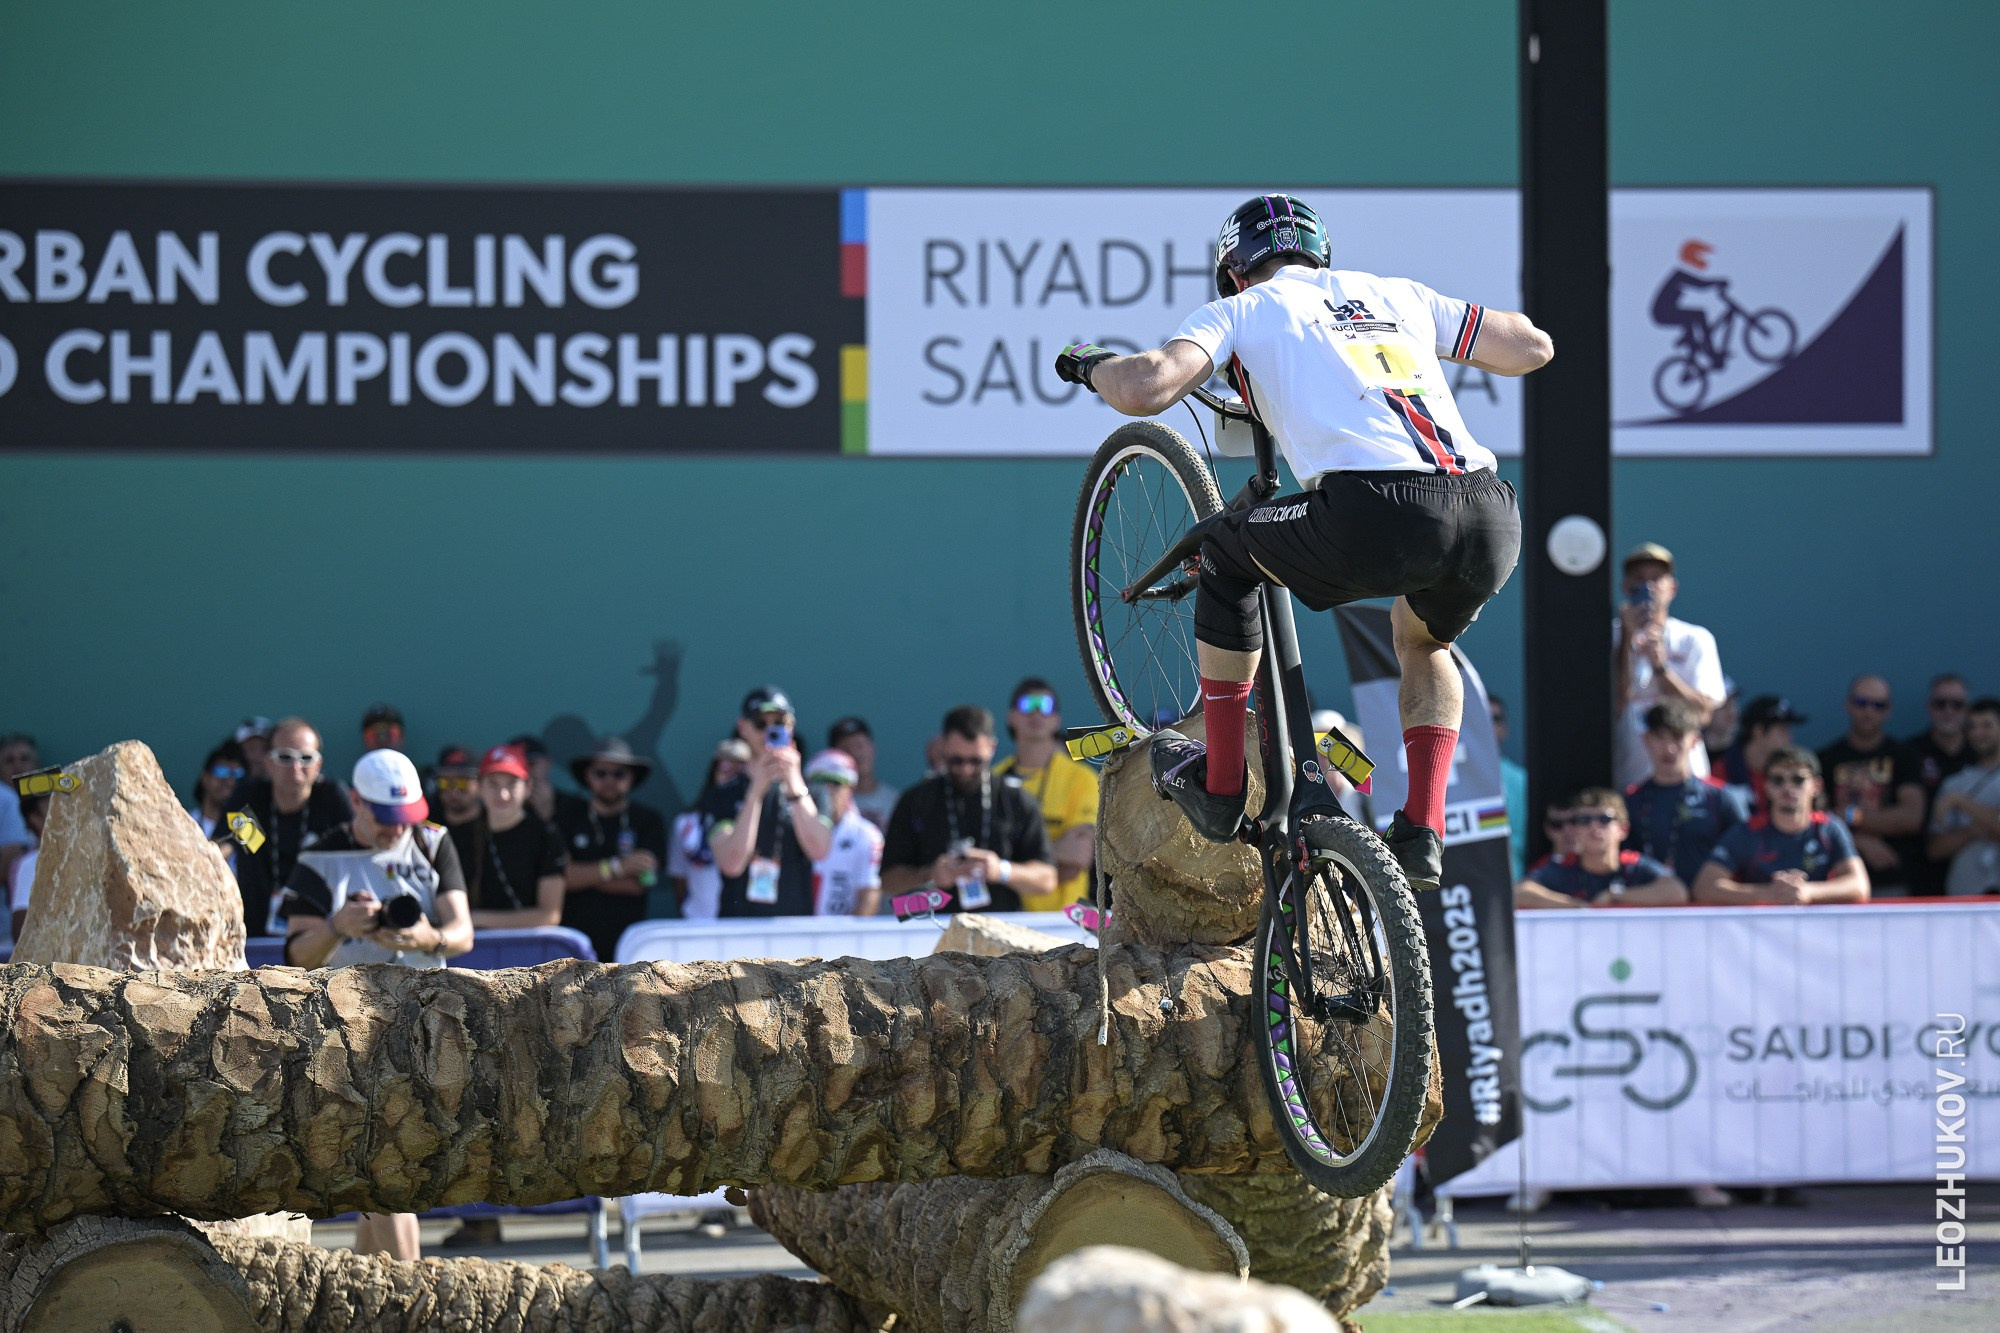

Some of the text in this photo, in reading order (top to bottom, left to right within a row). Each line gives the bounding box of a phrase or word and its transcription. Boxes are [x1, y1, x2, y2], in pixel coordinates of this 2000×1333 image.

[246, 231, 641, 309] CYCLING
[922, 238, 1217, 308] RIYADH
[1335, 324, 1354, 332] UCI
[44, 329, 819, 408] CHAMPIONSHIPS
[922, 335, 1169, 406] SAU
[1375, 351, 1392, 374] 1
[1113, 731, 1128, 743] 3A
[1445, 808, 1471, 836] CI
[1441, 884, 1502, 1126] #Riyadh2025
[1726, 1021, 1891, 1063] SAUDI
